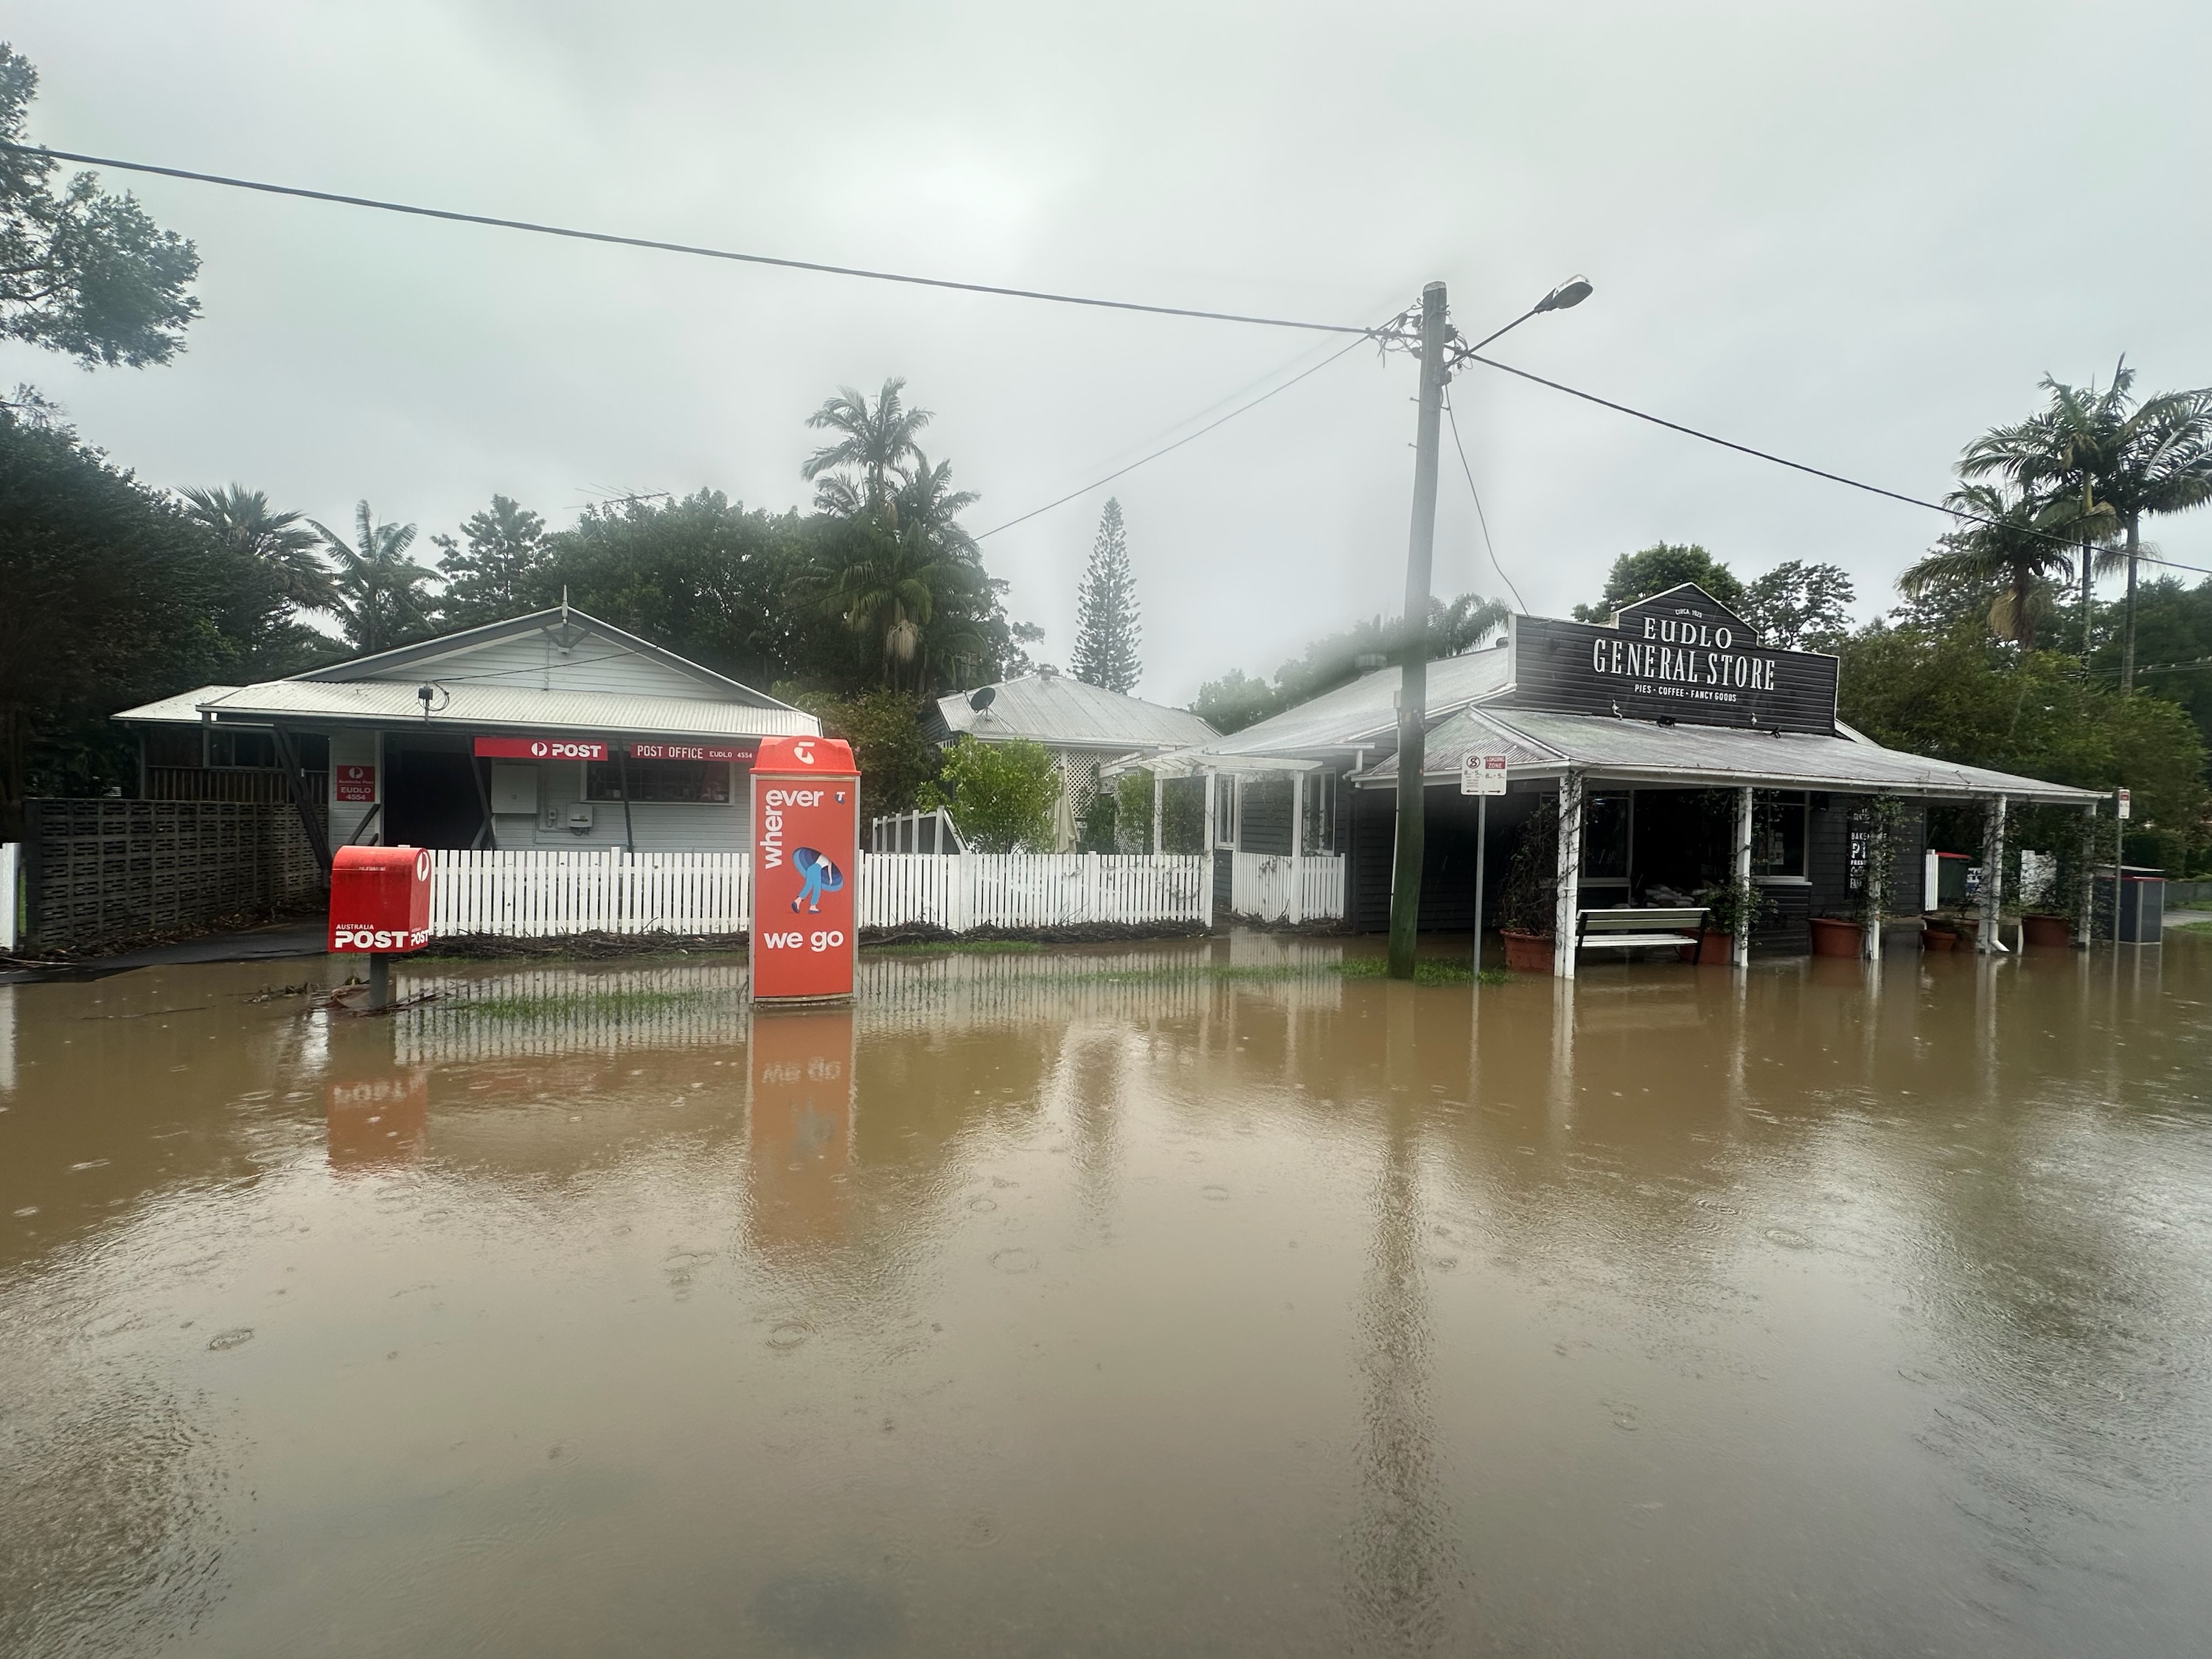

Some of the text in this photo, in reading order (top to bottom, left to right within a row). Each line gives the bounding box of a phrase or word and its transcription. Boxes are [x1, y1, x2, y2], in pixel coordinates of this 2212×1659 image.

[1644, 617, 1732, 649] EUDLO
[1593, 639, 1775, 691] GENERAL STORE
[1635, 684, 1737, 702] PIES COFFEE FANCY GOODS
[552, 743, 602, 758] POST
[637, 745, 663, 757] POST
[668, 746, 703, 759] OFFICE
[335, 930, 428, 949] POST POST
[763, 931, 844, 953] we go
